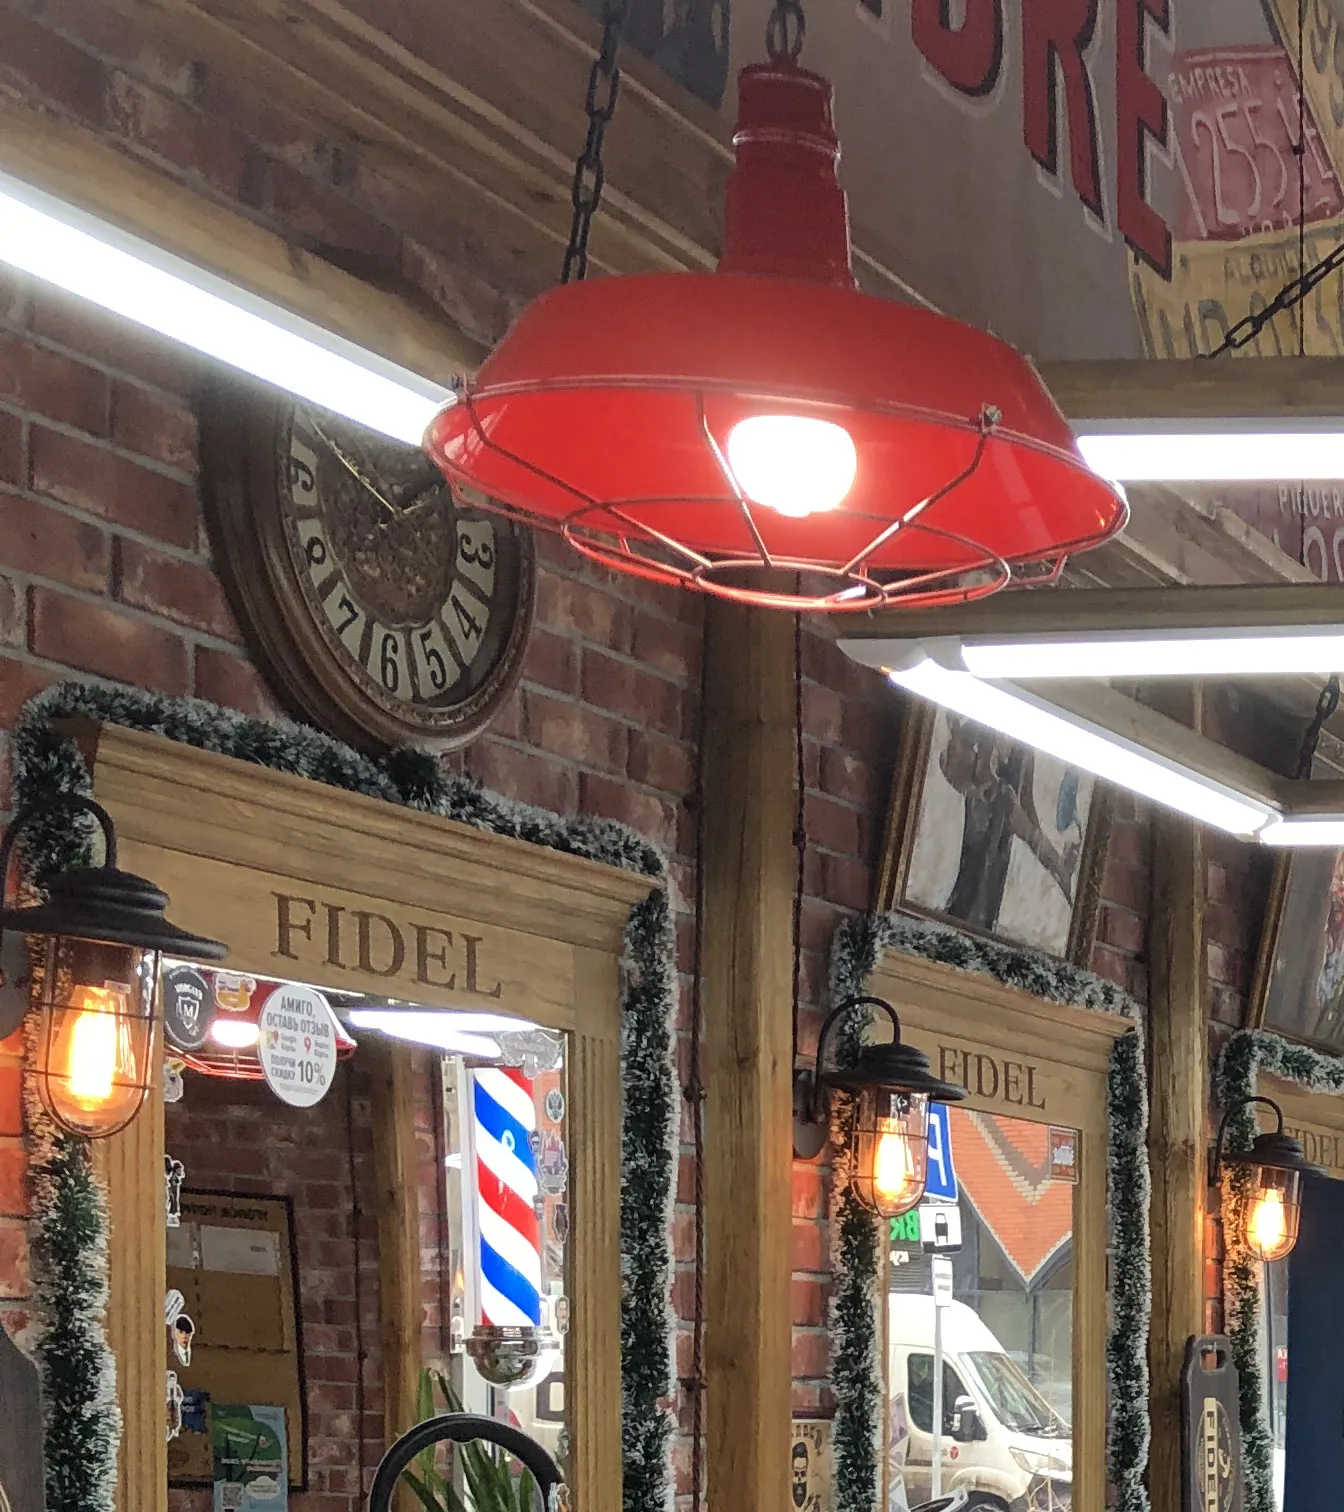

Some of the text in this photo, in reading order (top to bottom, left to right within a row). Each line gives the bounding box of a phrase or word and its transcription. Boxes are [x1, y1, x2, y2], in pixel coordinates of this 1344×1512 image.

[1168, 66, 1252, 103] EMPRESA
[451, 595, 483, 642] 4
[381, 633, 398, 692] 6
[420, 629, 447, 689] 5
[270, 890, 502, 998] FIDEL
[266, 1012, 329, 1038] ОСТАВЬ ОТЗЫВ
[281, 996, 315, 1018] АМИГО,
[298, 1060, 326, 1087] 10%
[938, 1044, 1046, 1110] FIDEL
